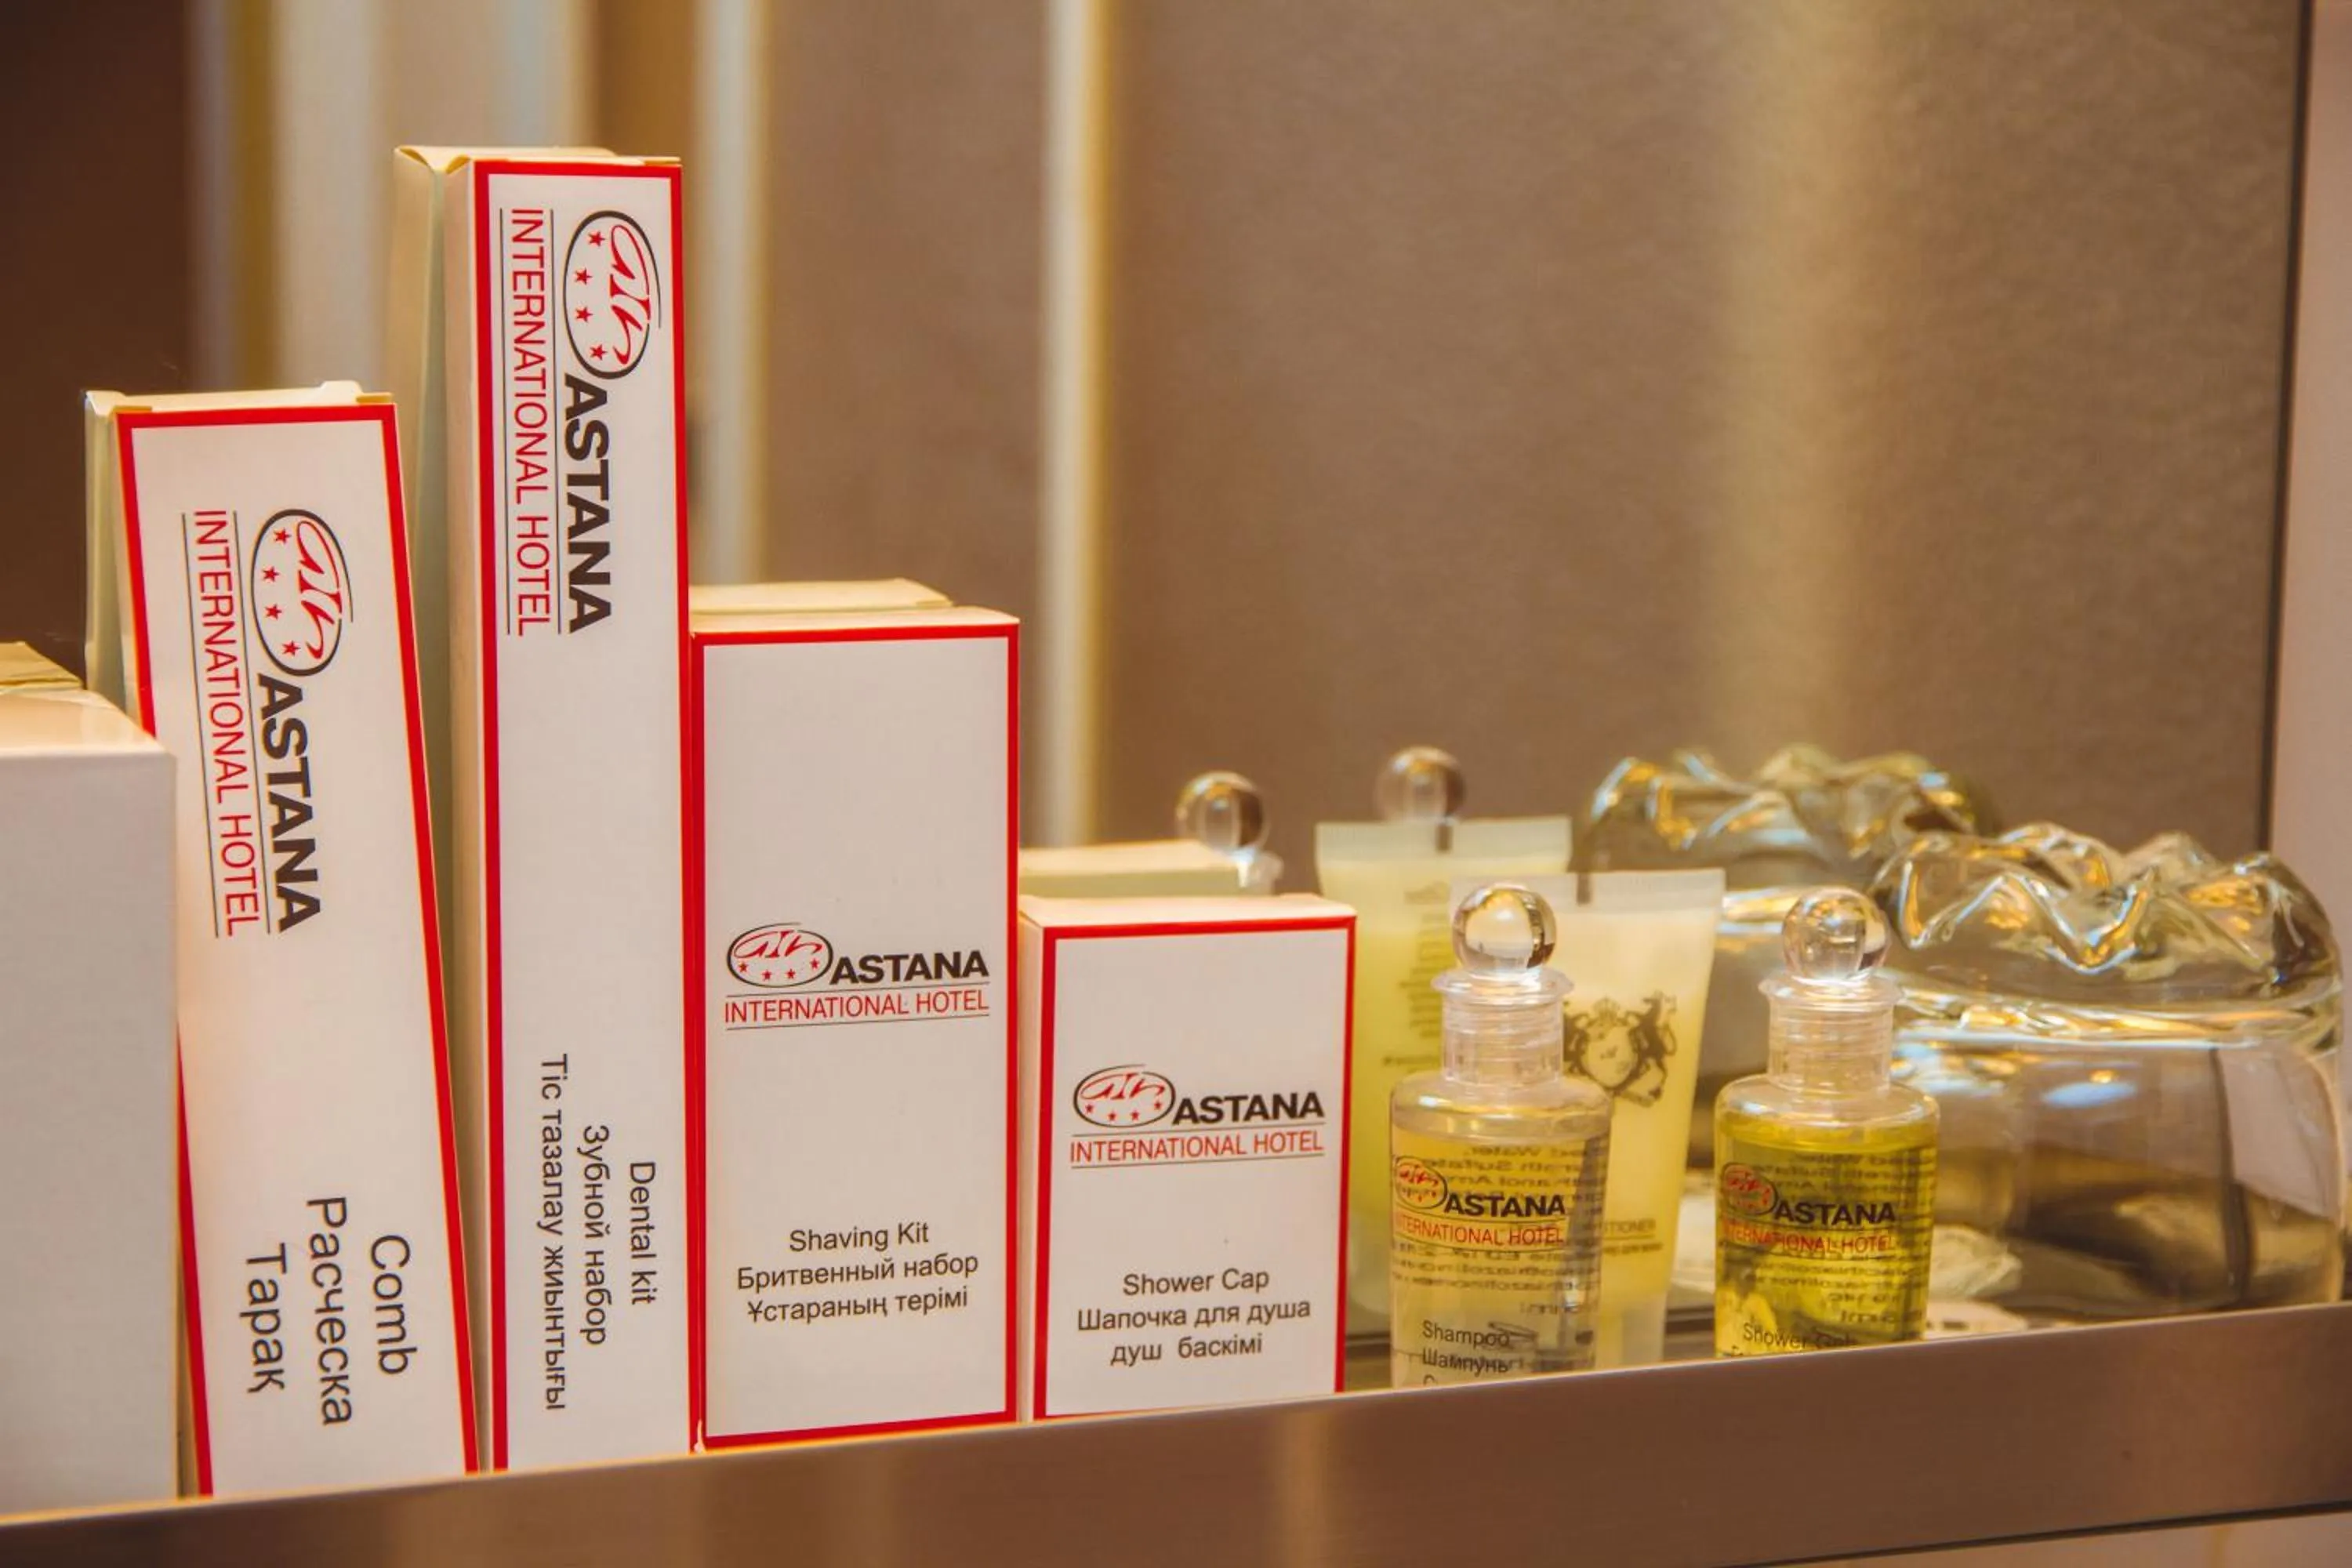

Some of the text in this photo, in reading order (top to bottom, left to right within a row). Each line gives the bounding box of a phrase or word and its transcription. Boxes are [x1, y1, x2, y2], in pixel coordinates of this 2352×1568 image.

[510, 209, 552, 637] INTERNATIONAL HOTEL
[564, 372, 612, 634] ASTANA
[194, 510, 260, 936] INTERNATIONAL HOTEL
[257, 673, 321, 933] ASTANA
[829, 949, 989, 985] ASTANA
[724, 989, 989, 1023] INTERNATIONAL HOTEL
[1171, 1091, 1325, 1126] ASTANA
[1069, 1130, 1323, 1163] INTERNATIONAL HOTEL
[536, 1109, 564, 1236] тазалау
[1443, 1193, 1566, 1218] ASTANA
[1774, 1200, 1896, 1225] ASTANA
[577, 1124, 612, 1346] Зубной набор
[629, 1161, 657, 1305] Dental kit
[789, 1221, 930, 1252] Shaving Kit
[1394, 1213, 1564, 1247] TERNATIONAL HOTEL
[1724, 1219, 1896, 1254] TERNATIONAL HOTEL
[737, 1252, 979, 1294] Бритвенный набор
[1123, 1268, 1270, 1296] Shower Cap
[306, 1196, 353, 1425] Расческа
[370, 1234, 418, 1374] Comb
[1076, 1300, 1311, 1331] Шапочка для душа
[543, 1245, 566, 1410] жиынтығы
[1422, 1319, 1511, 1350] Shampoo
[1743, 1322, 1806, 1349] Shower
[1109, 1343, 1162, 1367] душ
[1422, 1346, 1510, 1377] Шампунь
